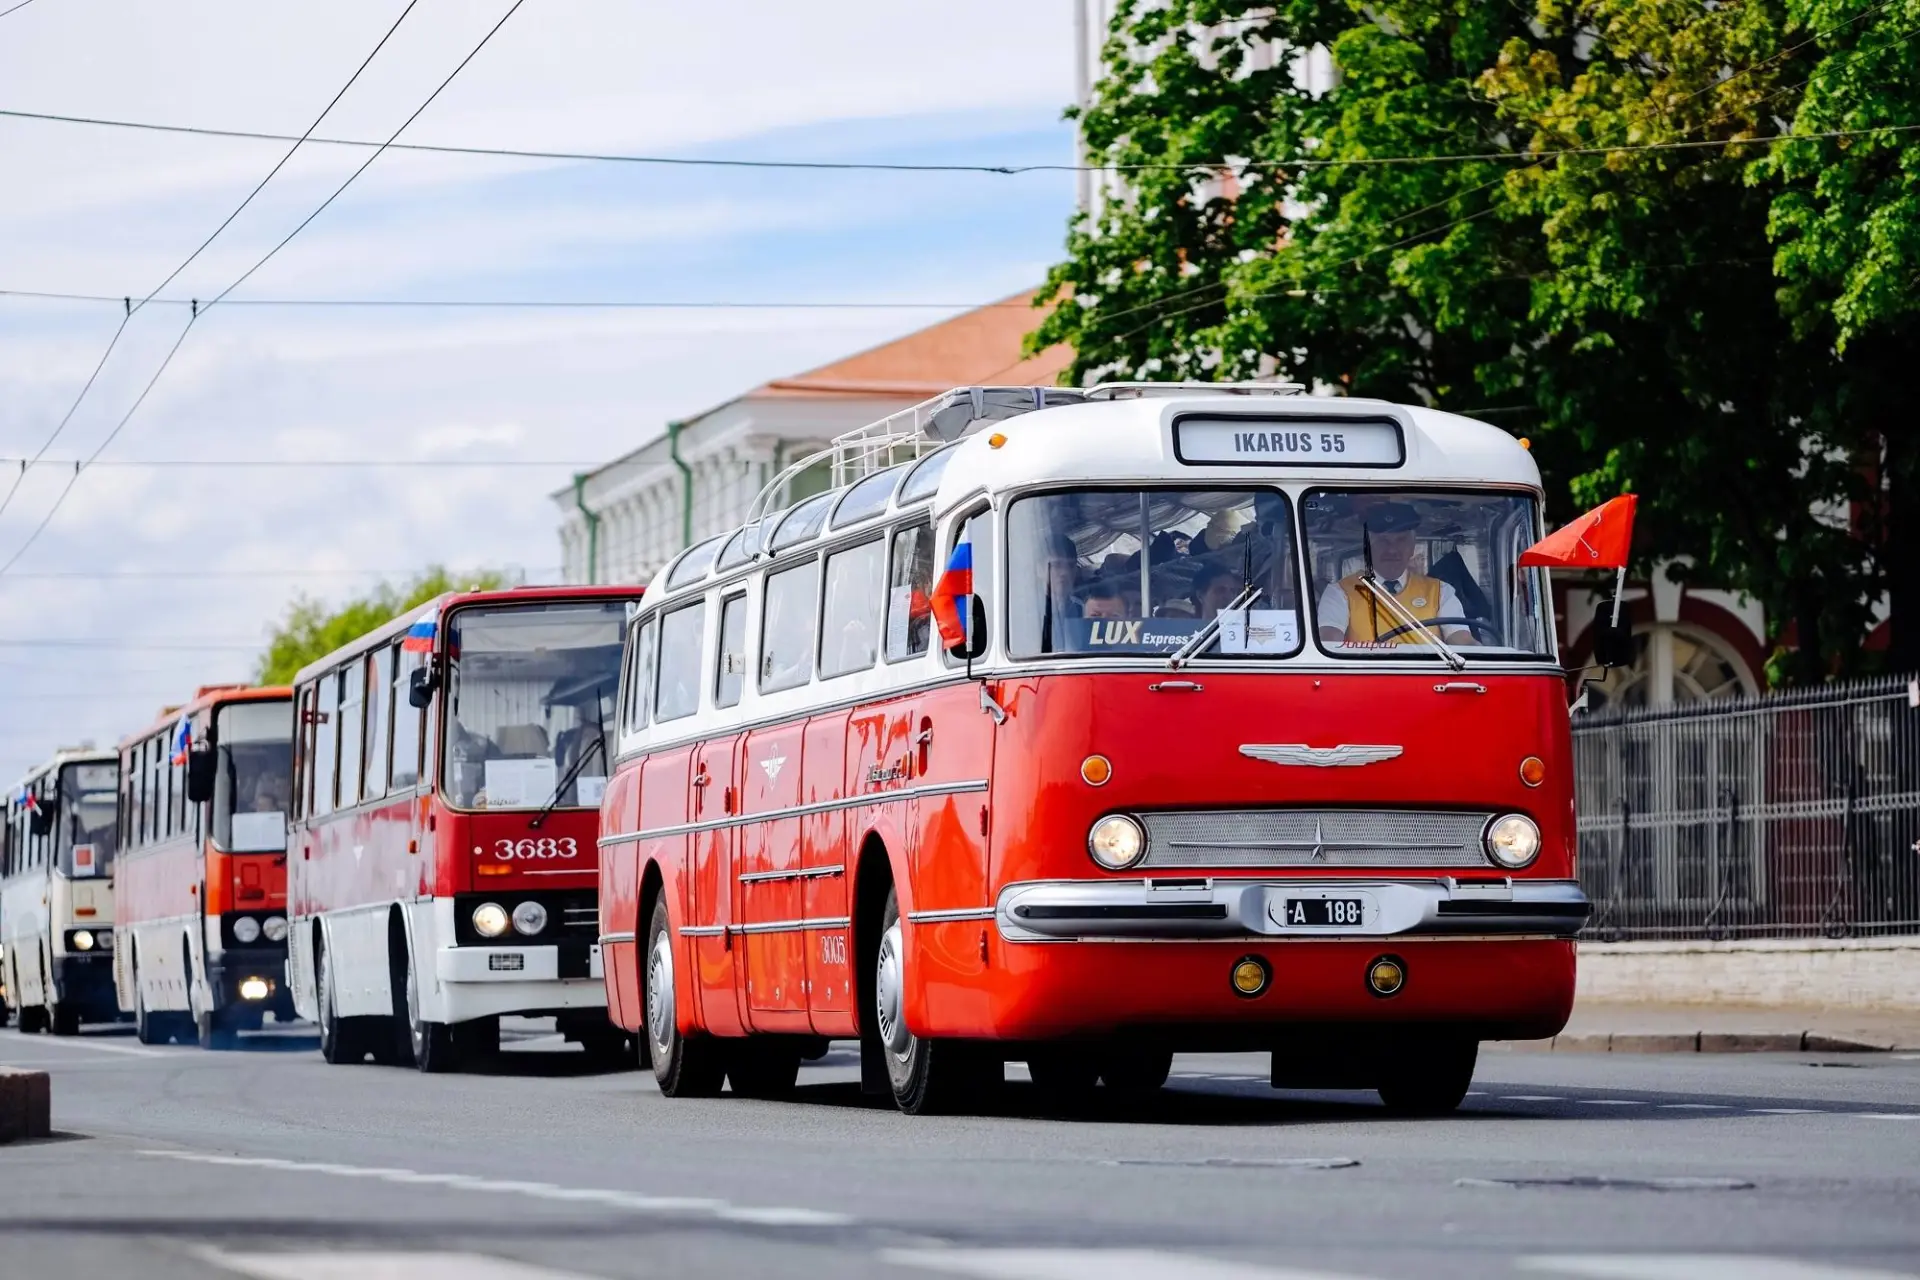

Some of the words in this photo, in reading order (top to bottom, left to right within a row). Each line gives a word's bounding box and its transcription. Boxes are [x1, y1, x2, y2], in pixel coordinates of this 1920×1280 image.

[1234, 433, 1313, 453] IKARUS
[1320, 434, 1346, 453] 55
[1089, 620, 1142, 645] LUX
[1142, 632, 1189, 647] Express
[1228, 630, 1236, 642] 3
[1283, 631, 1292, 642] 2
[495, 837, 578, 860] 3683
[1293, 901, 1306, 923] A
[1325, 901, 1357, 923] 188
